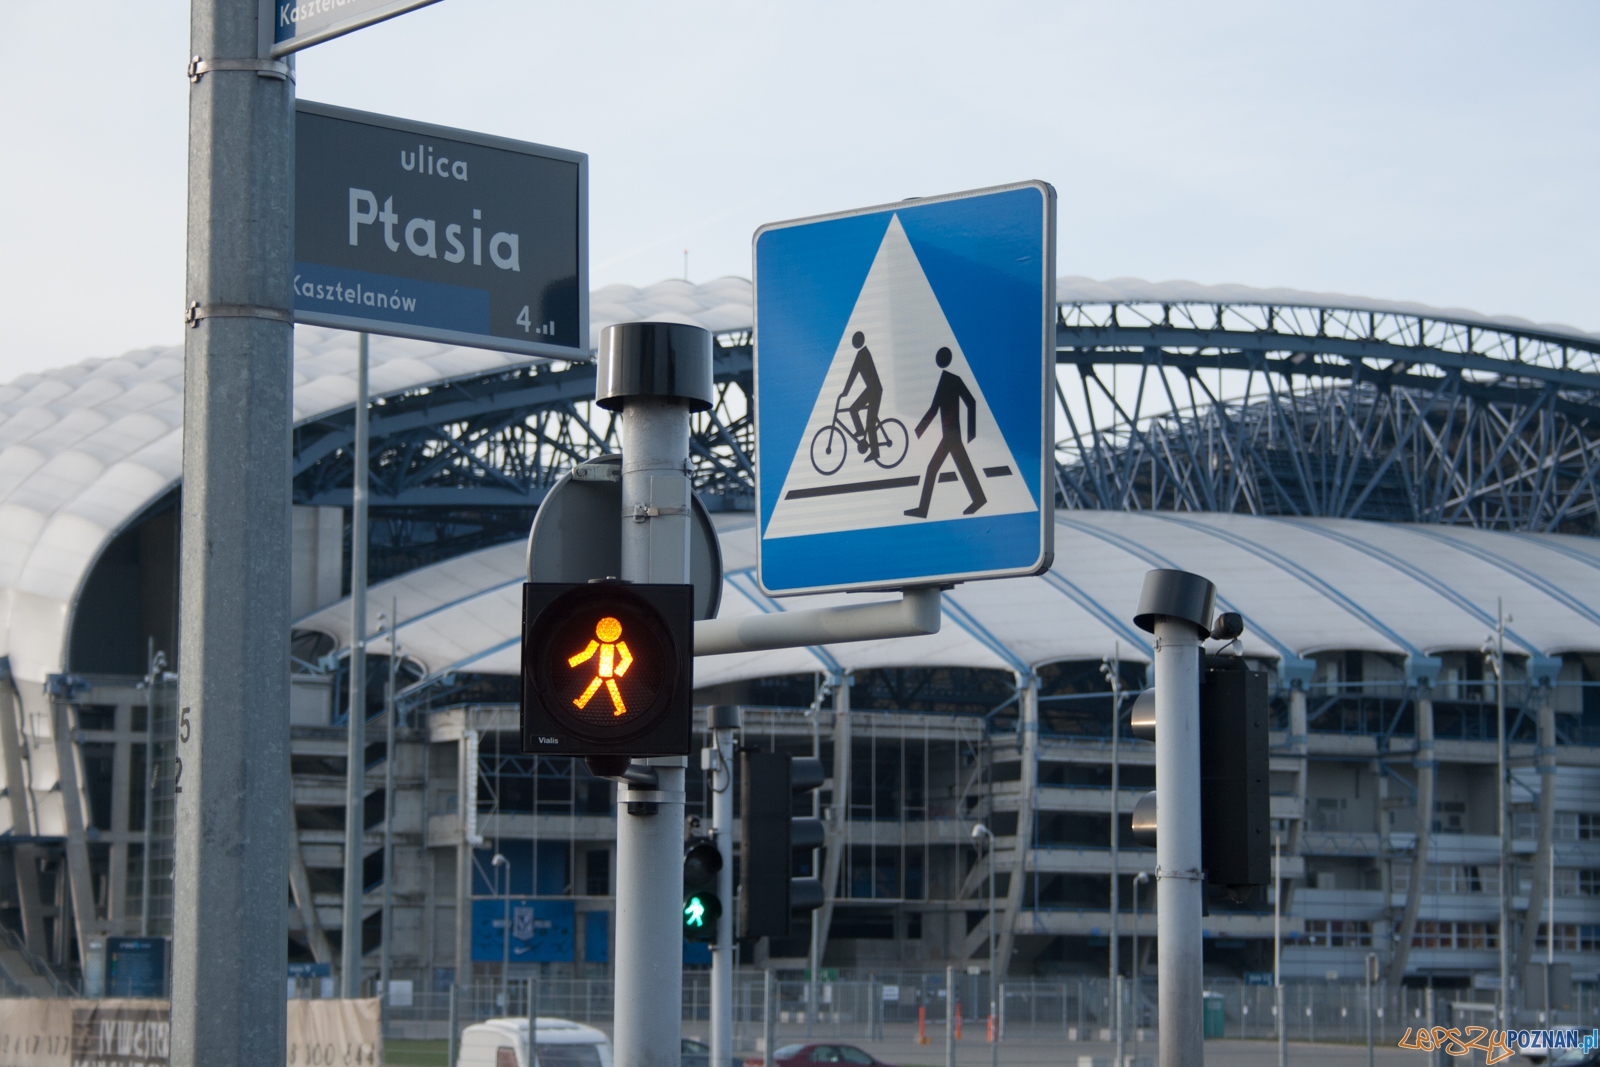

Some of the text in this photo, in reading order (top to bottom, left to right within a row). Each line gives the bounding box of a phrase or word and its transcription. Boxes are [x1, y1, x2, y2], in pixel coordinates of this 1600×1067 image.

[401, 144, 468, 182] ulica
[348, 187, 521, 272] Ptasia
[180, 707, 190, 743] 5
[538, 736, 559, 744] Vialis
